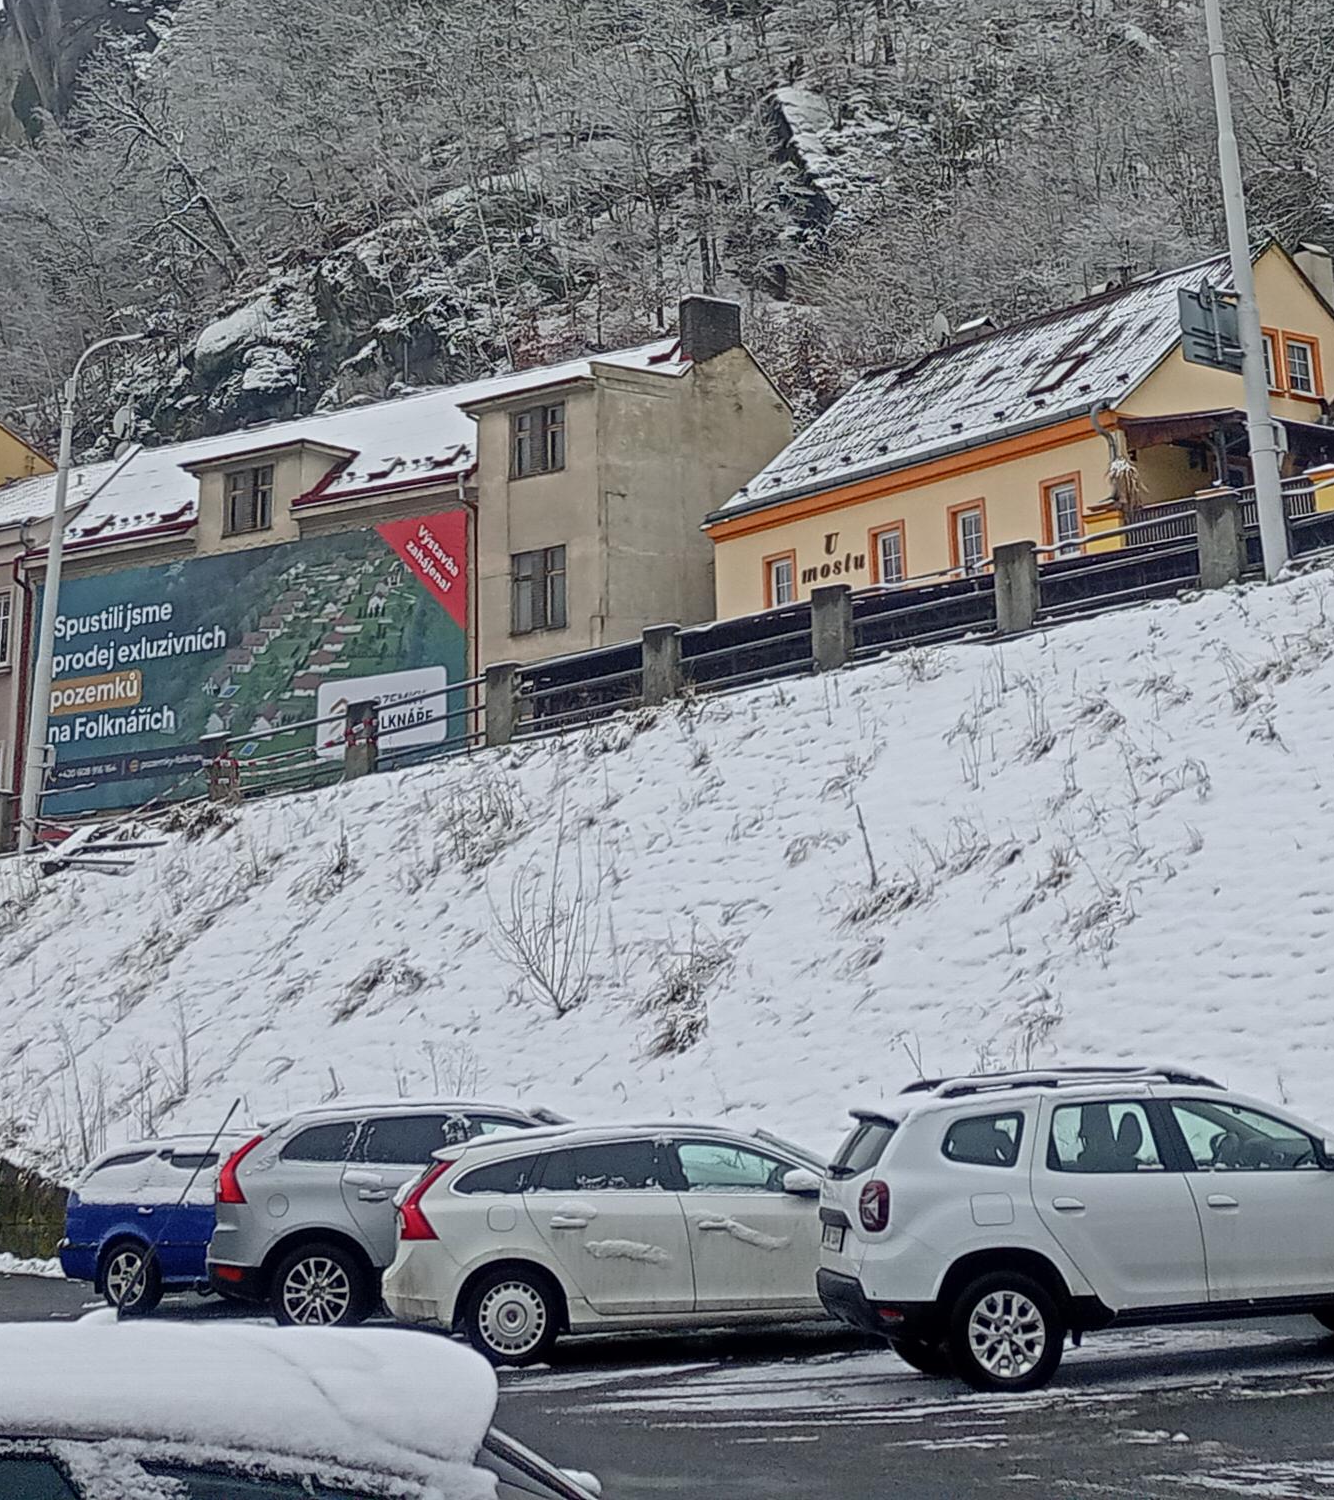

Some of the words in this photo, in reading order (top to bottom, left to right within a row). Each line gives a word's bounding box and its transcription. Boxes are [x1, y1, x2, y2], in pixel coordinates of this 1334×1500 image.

[418, 525, 459, 577] Výstavba
[824, 532, 840, 555] U
[406, 541, 451, 592] zahájena!
[54, 604, 123, 641] Spustili
[124, 603, 172, 632] jsme
[52, 641, 115, 677] prodej
[117, 625, 226, 663] exluzivních
[49, 672, 137, 712] pozemků
[49, 724, 70, 743] na
[74, 705, 175, 740] Folknářích
